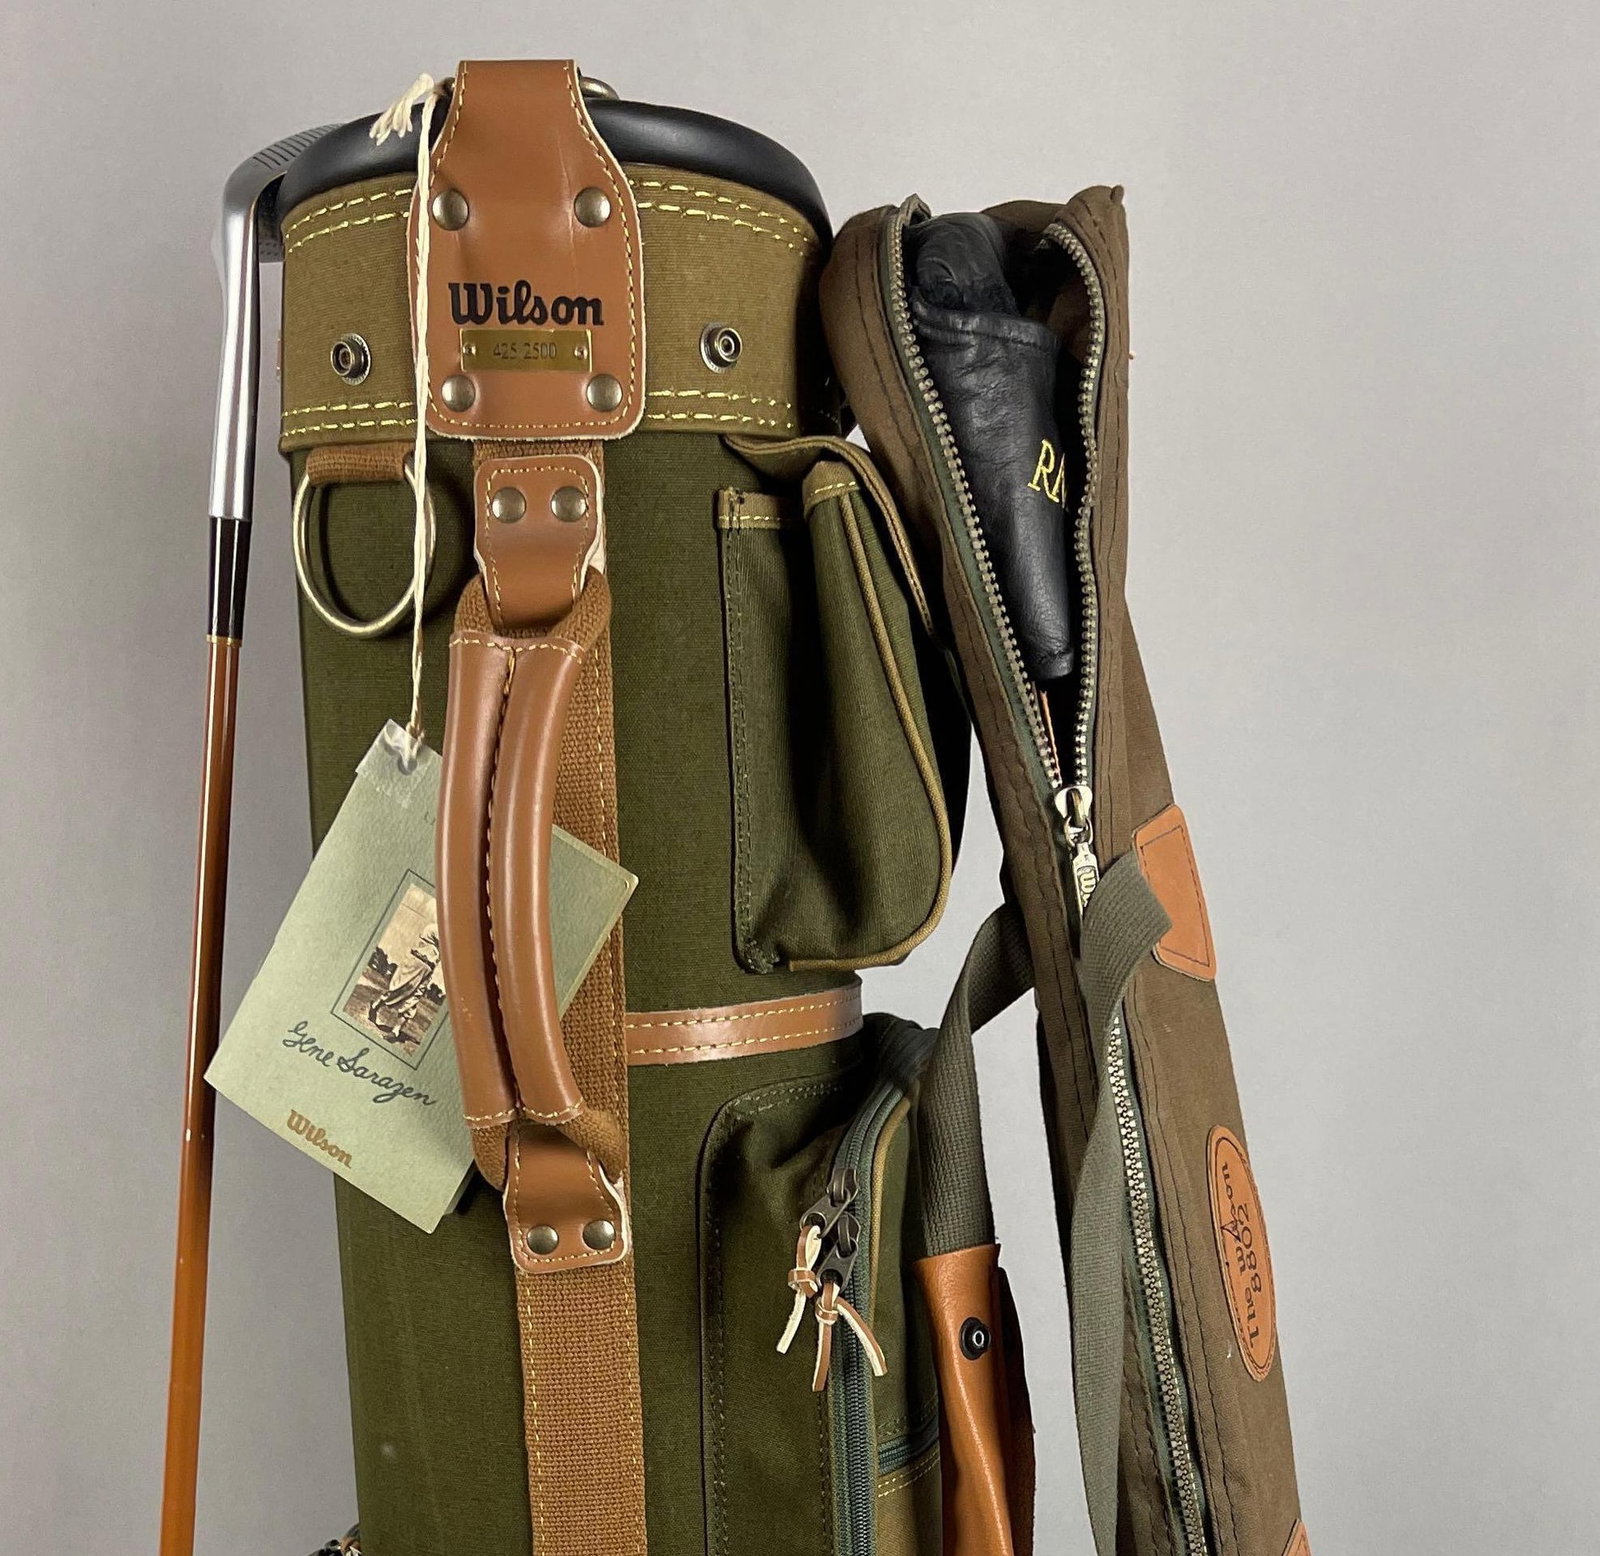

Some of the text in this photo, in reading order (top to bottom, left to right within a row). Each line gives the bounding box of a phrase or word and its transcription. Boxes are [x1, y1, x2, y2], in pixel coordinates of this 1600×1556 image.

[448, 280, 604, 326] Wilson
[282, 1020, 437, 1106] Gene Sarazen
[286, 1109, 353, 1169] Wilson
[1237, 1202, 1263, 1294] 8802
[1245, 1286, 1262, 1349] The
